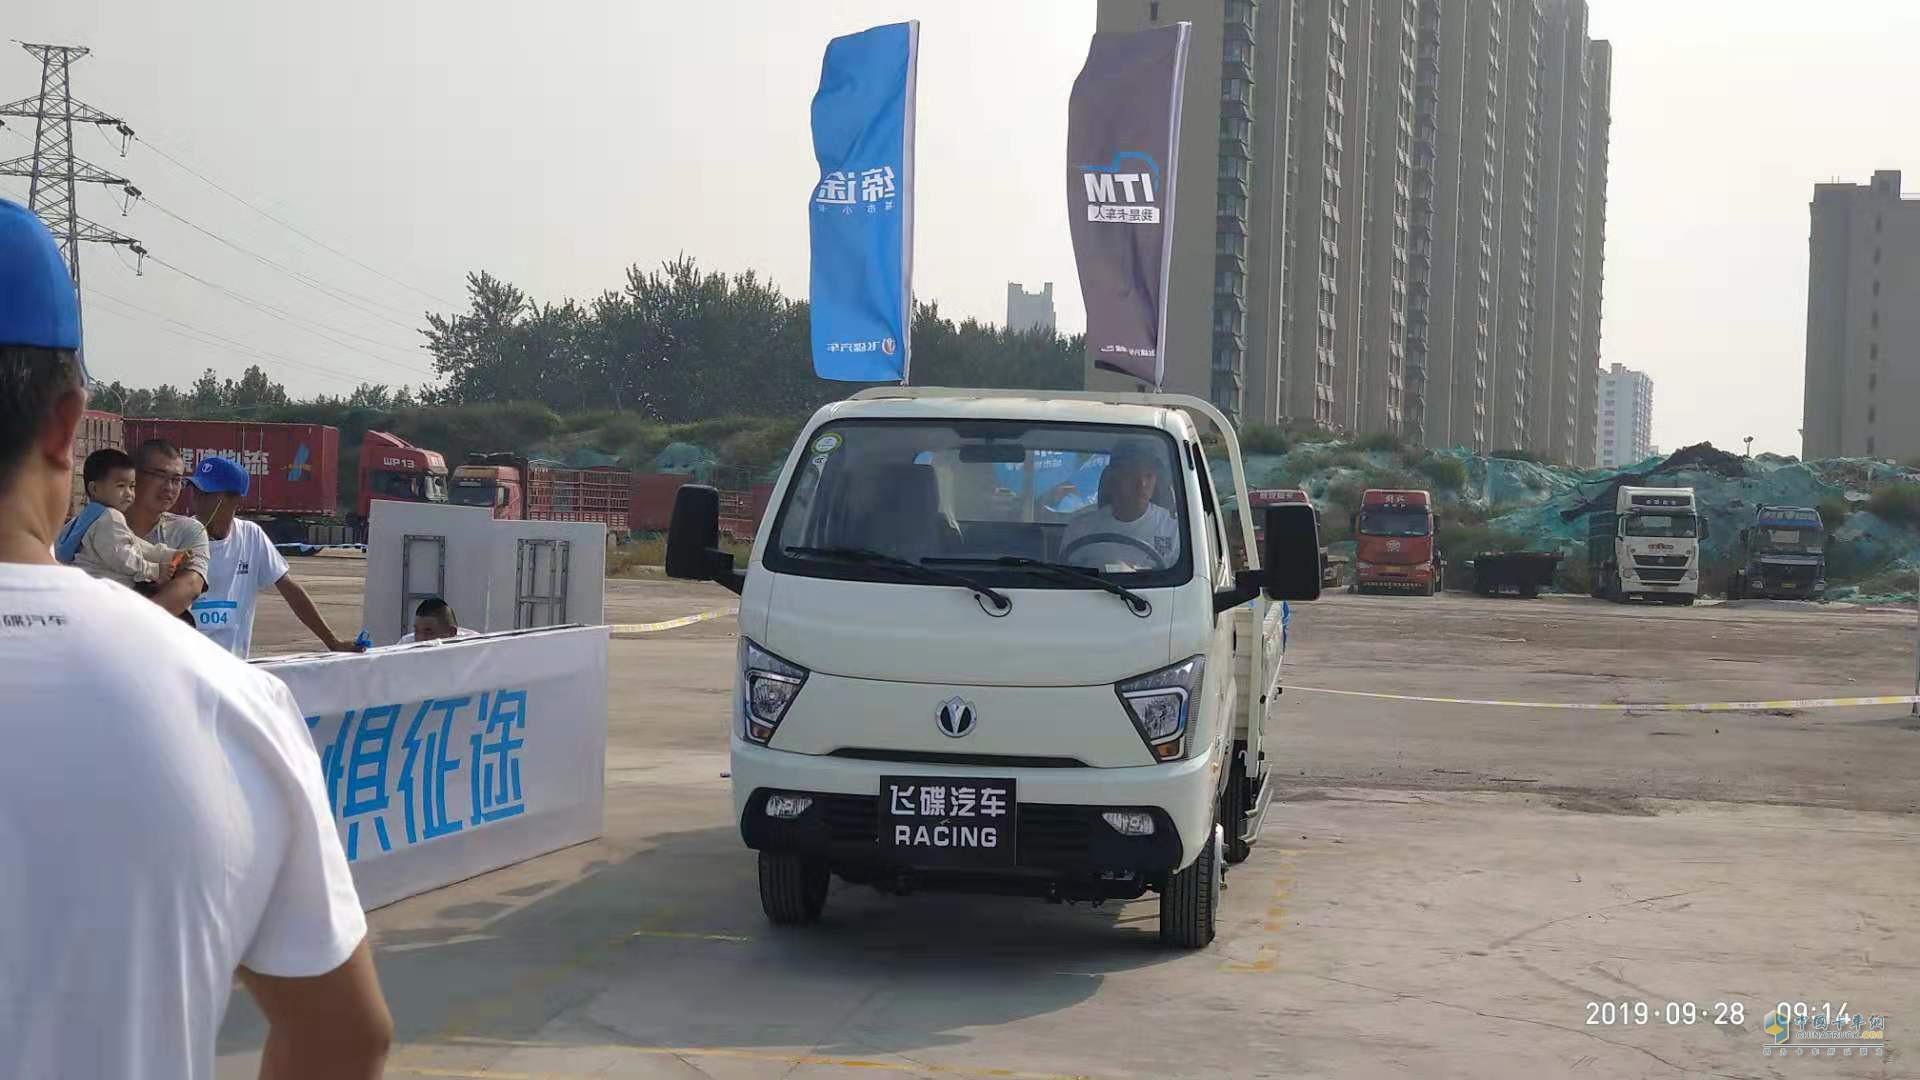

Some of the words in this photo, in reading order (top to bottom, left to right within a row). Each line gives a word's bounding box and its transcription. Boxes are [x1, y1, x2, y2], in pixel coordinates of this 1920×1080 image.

[199, 611, 228, 624] 004
[303, 689, 527, 862] 惧征途
[890, 784, 1007, 817] 飞碟汽车
[895, 825, 997, 848] RACING
